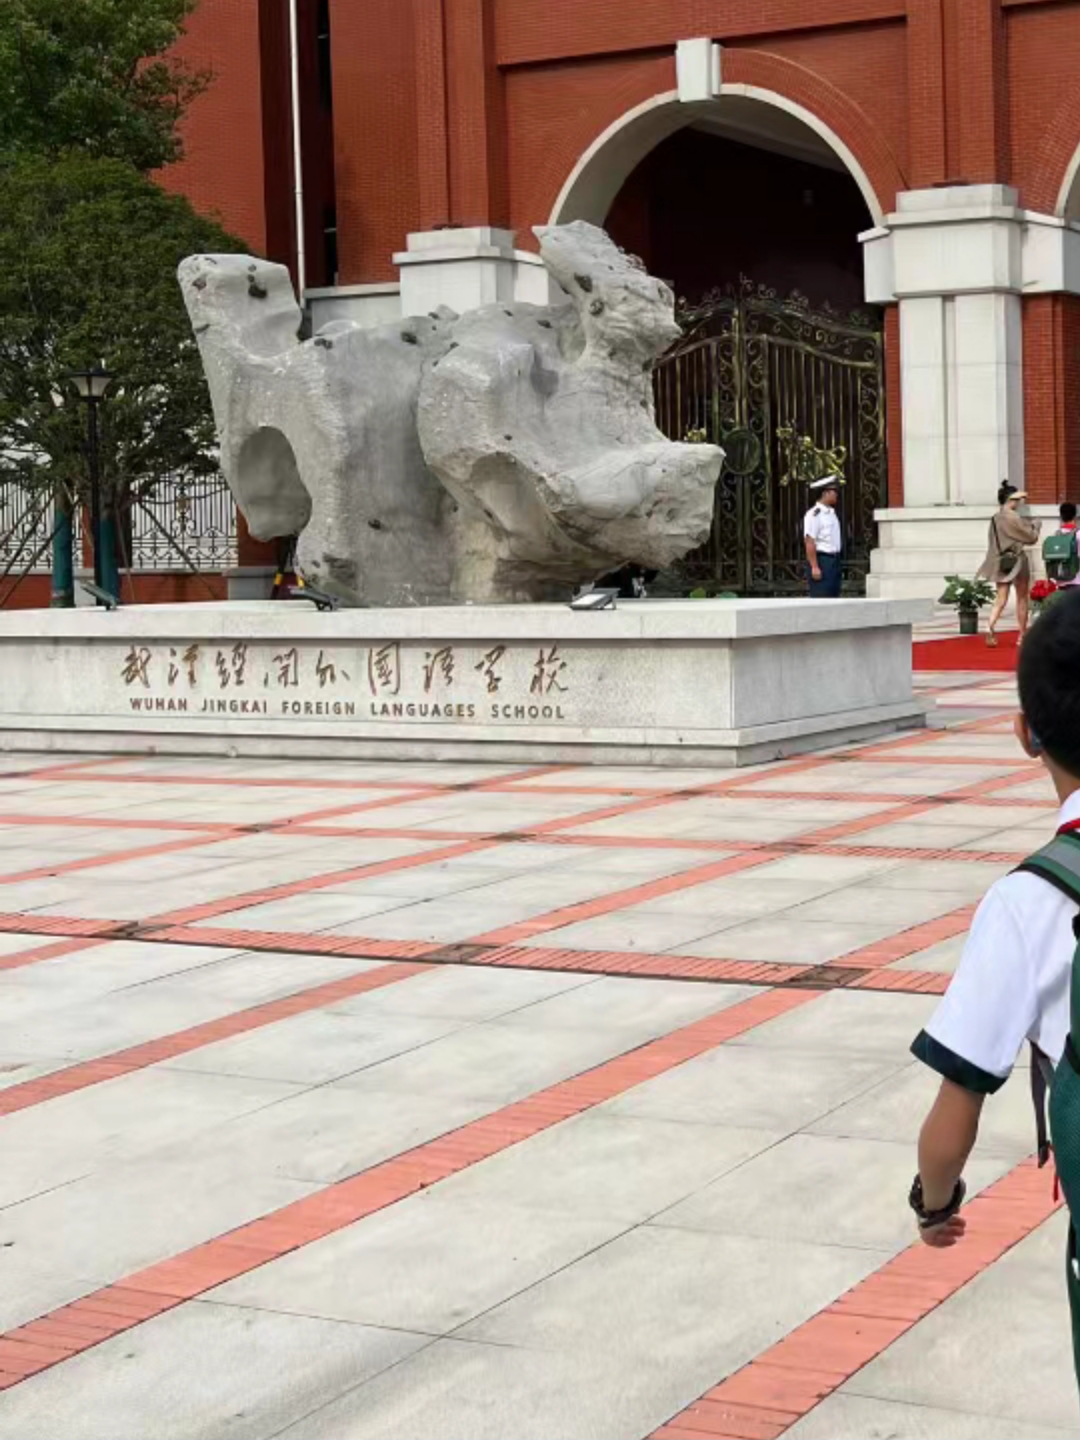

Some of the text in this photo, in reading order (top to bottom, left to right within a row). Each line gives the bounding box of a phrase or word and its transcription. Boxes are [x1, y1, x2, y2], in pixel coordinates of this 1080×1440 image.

[129, 698, 565, 719] WUHAN JINGKAI FOREIGN LANGUAGES SCHOOL
